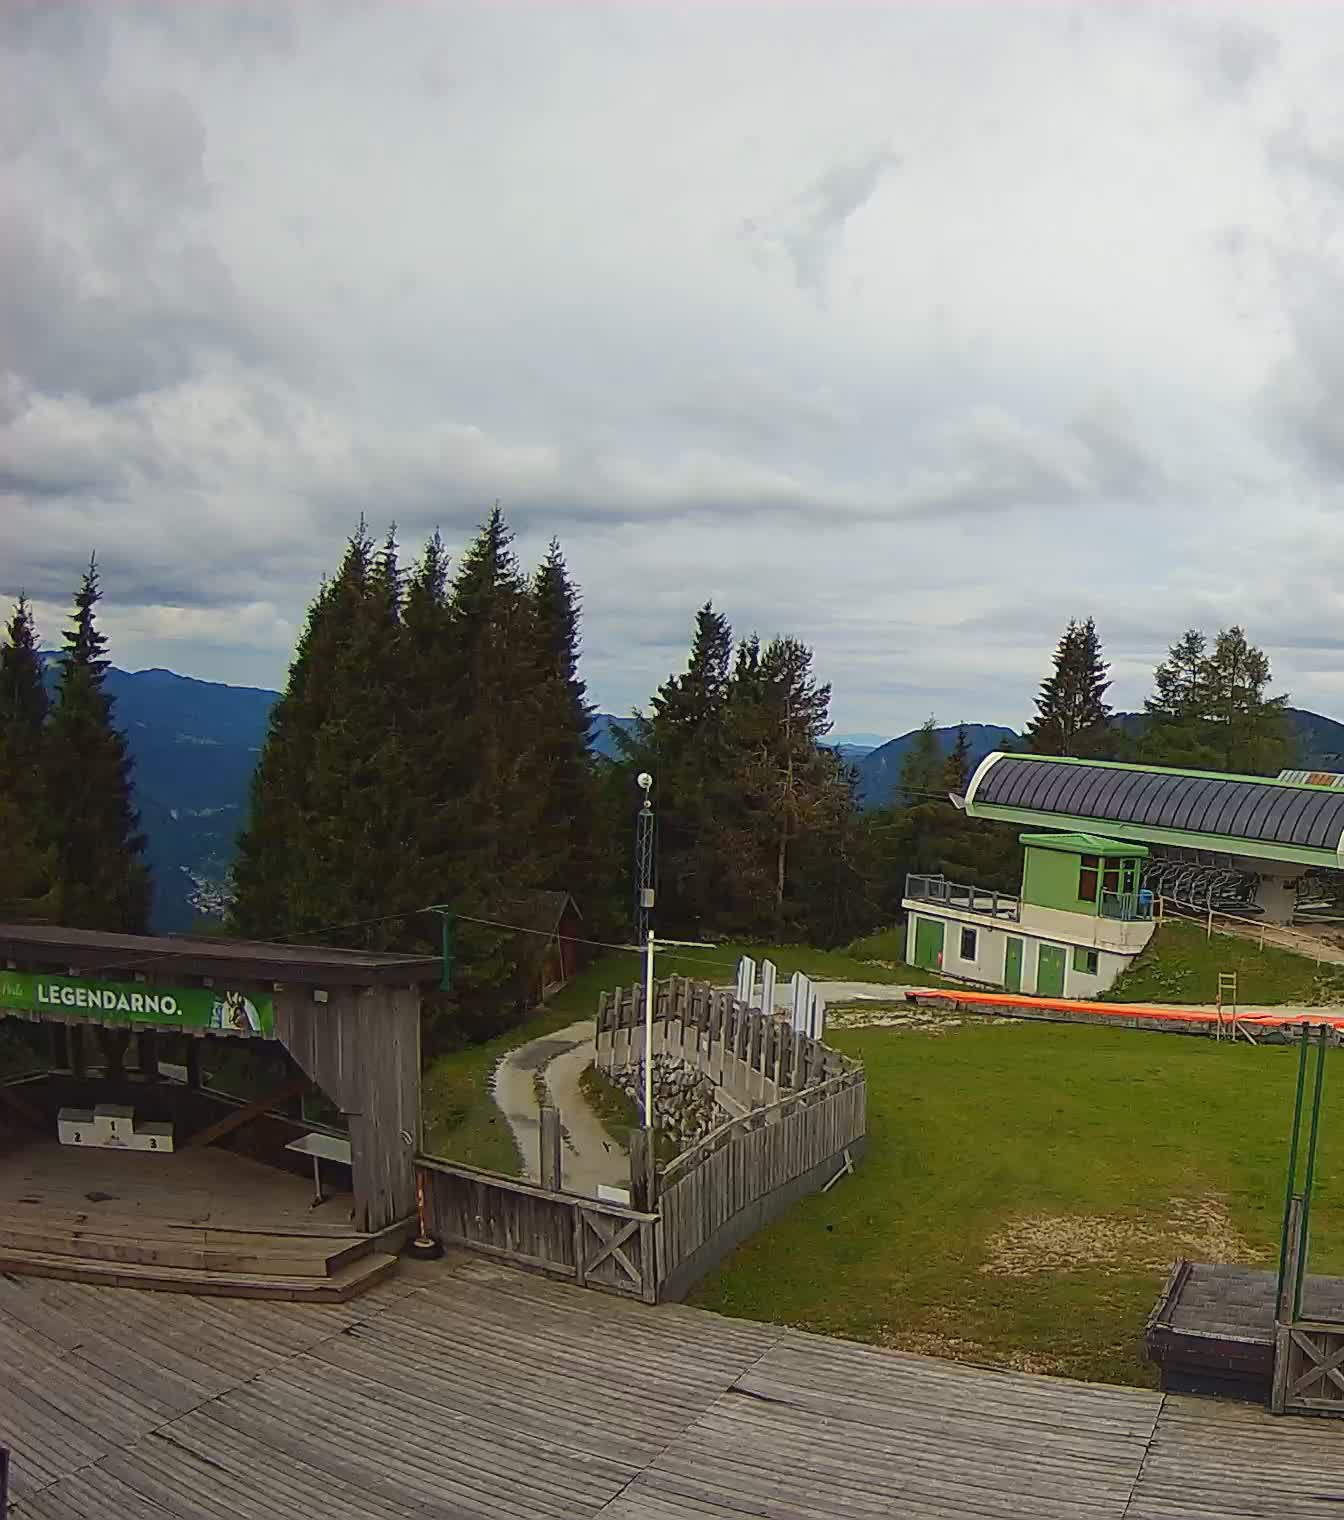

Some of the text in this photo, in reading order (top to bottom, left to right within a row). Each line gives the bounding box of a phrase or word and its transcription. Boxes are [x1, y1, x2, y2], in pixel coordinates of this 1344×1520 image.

[37, 983, 183, 1016] LEGENDARNO.
[74, 1131, 82, 1143] 2
[149, 1138, 158, 1149] 3
